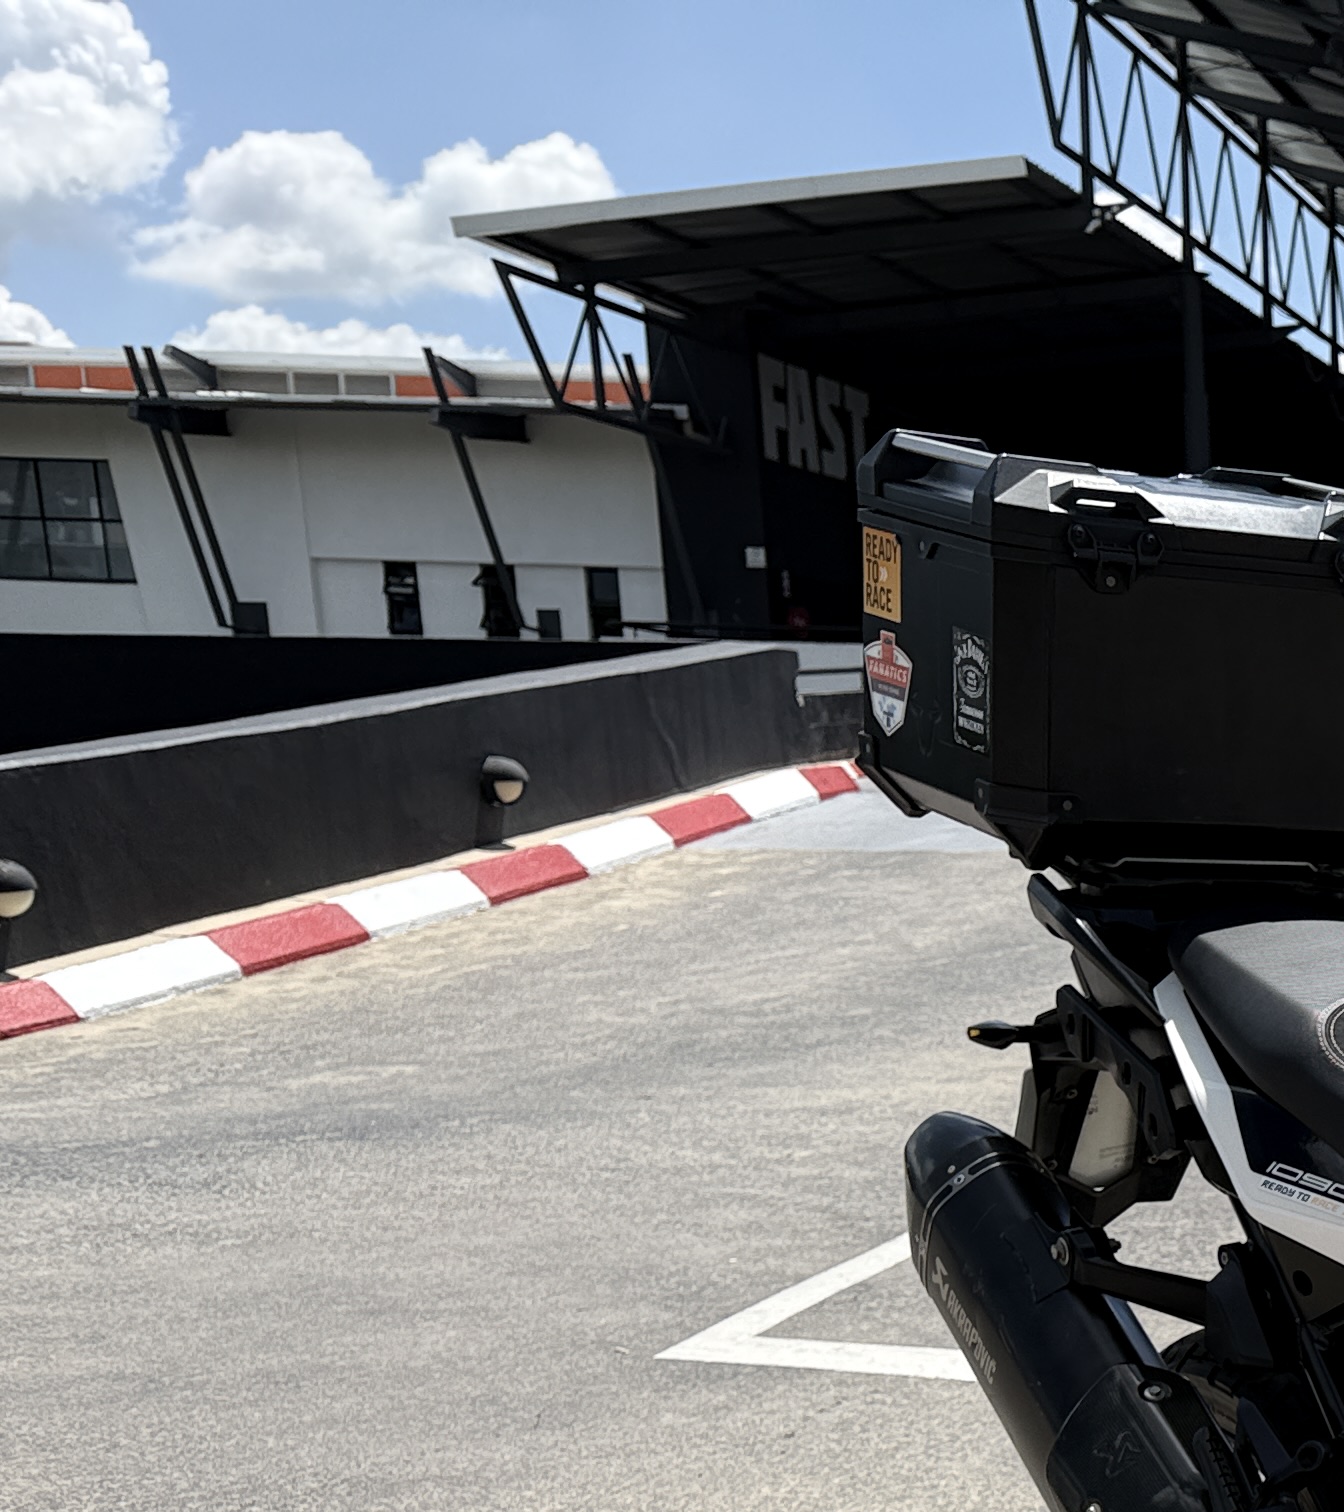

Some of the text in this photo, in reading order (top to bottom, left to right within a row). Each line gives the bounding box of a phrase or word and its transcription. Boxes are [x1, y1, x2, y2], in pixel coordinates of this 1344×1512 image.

[757, 351, 870, 481] FAST
[865, 532, 898, 565] READY
[866, 557, 880, 584] TO
[865, 582, 893, 613] RACE
[868, 659, 909, 684] FANATICS
[1261, 1179, 1297, 1198] READY
[1296, 1191, 1312, 1203] TO
